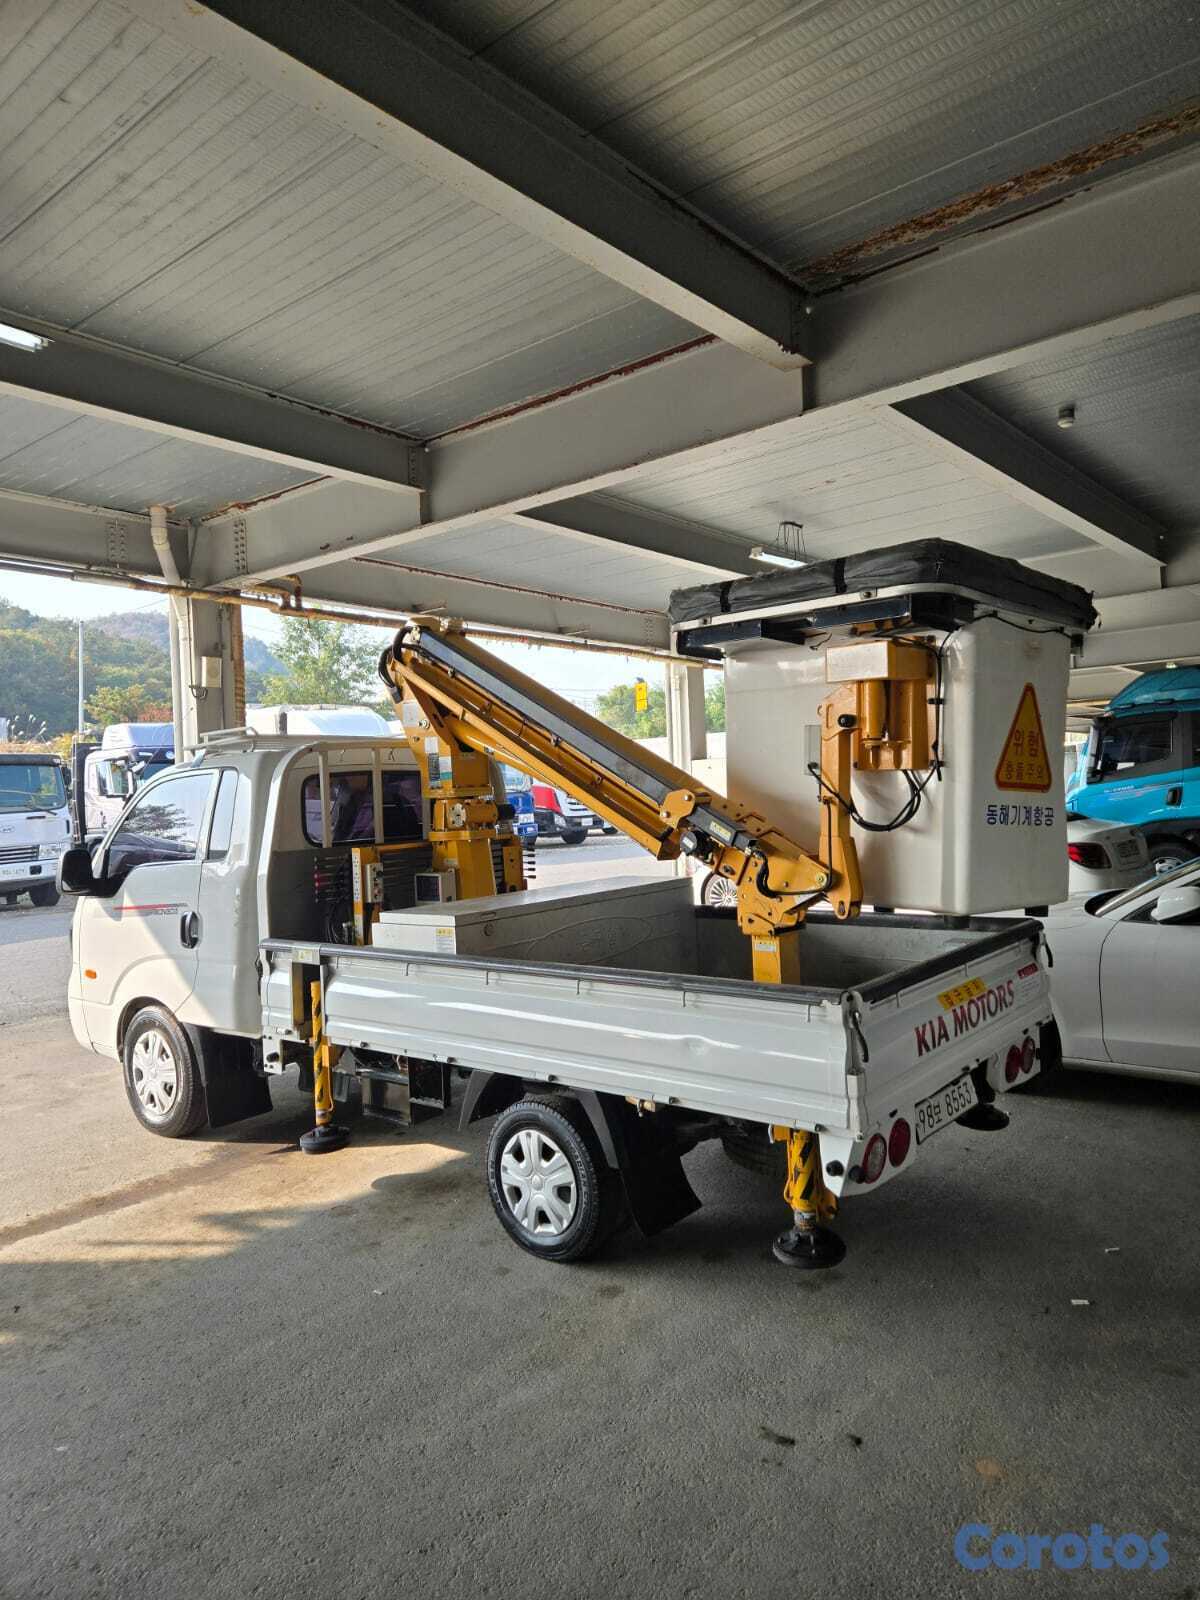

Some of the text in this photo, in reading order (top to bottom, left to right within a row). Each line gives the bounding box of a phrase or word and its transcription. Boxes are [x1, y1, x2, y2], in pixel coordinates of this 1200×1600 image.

[986, 804, 1054, 826] 동해기계항공
[914, 1015, 950, 1057] KIA
[952, 980, 1015, 1037] MOTORS
[945, 1081, 972, 1116] 8553
